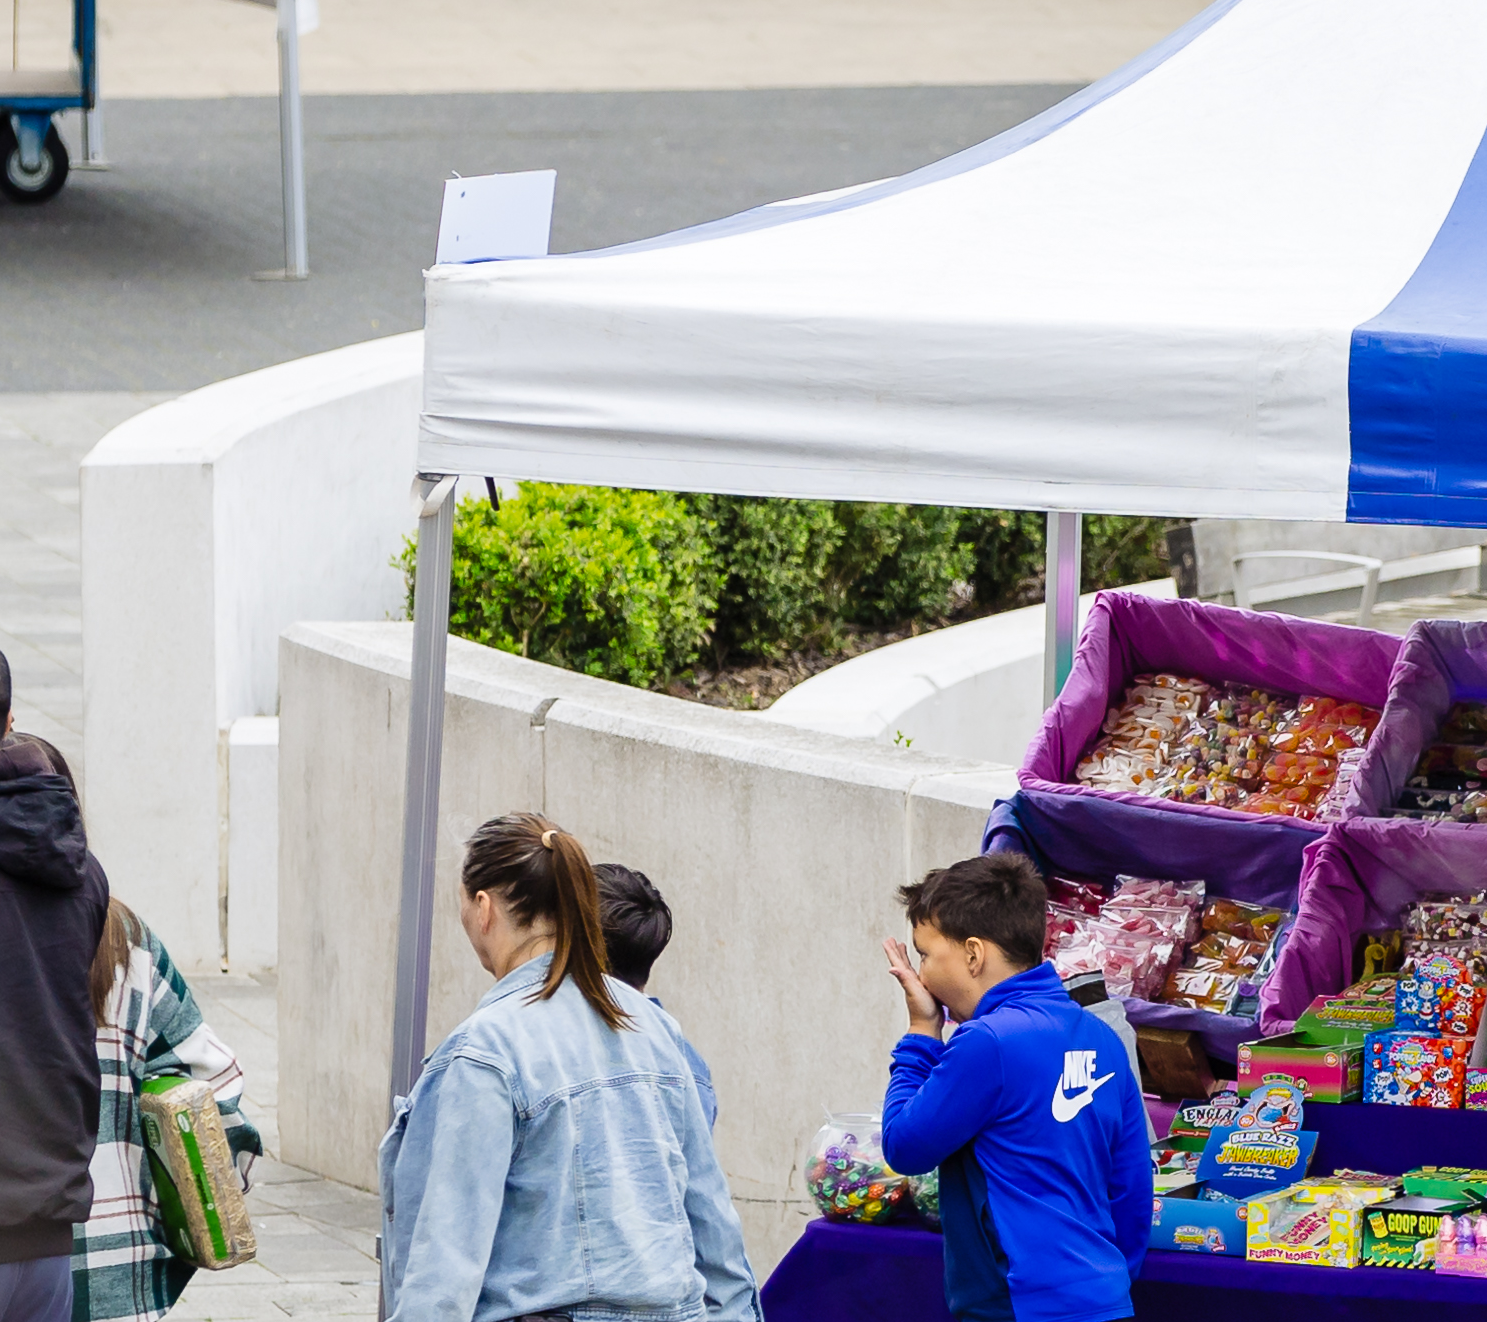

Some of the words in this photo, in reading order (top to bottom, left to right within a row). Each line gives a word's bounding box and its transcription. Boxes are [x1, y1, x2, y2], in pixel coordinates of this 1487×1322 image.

[1231, 1131, 1261, 1145] BLUE
[1261, 1131, 1296, 1148] RAZZ
[1216, 1144, 1299, 1169] JAWBREAKER
[1280, 1211, 1319, 1241] FUNNY
[1287, 1216, 1328, 1246] MONEY
[1388, 1212, 1417, 1234] GOOP
[1248, 1248, 1284, 1260] FUNNY
[1285, 1249, 1320, 1261] MONEY
